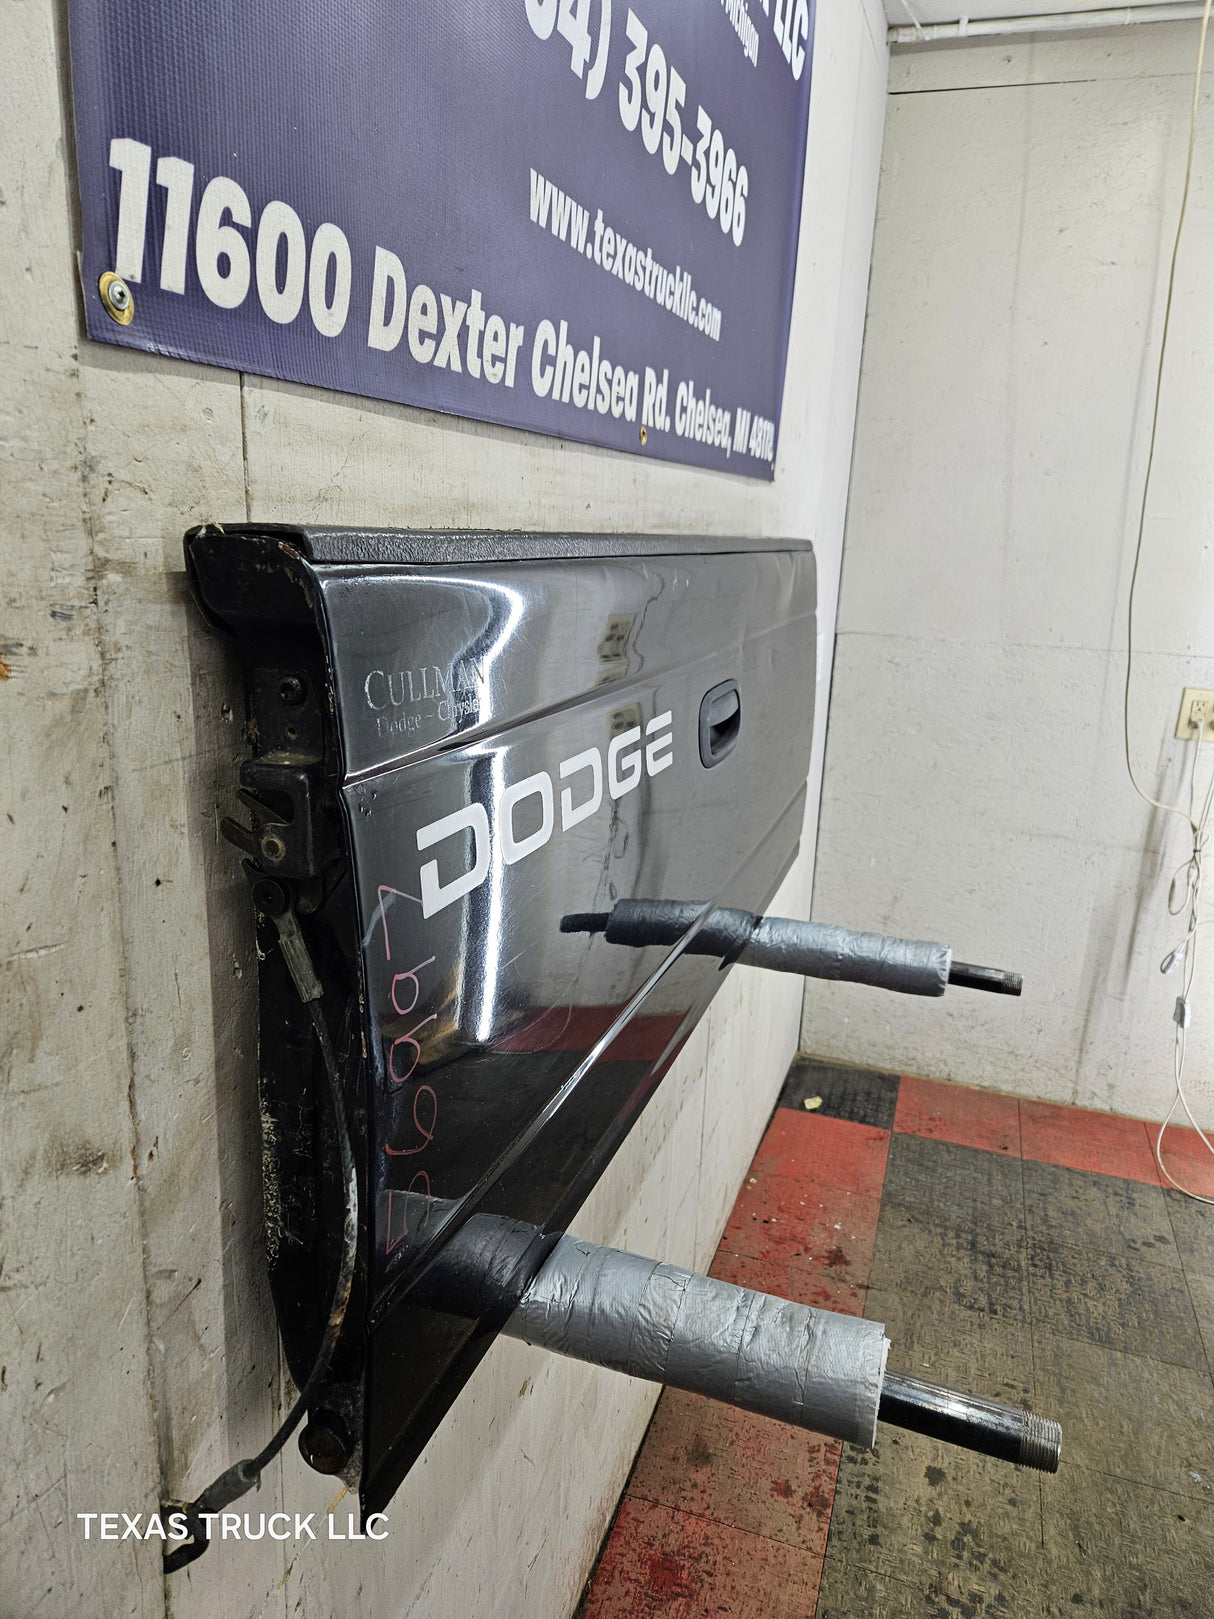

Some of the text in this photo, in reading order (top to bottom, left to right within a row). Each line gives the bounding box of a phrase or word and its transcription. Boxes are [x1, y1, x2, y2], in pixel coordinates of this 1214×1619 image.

[618, 7, 748, 248] 395-3966
[109, 137, 352, 338] 11600
[367, 245, 525, 388] Dexter
[531, 319, 639, 422] Chelsea
[642, 366, 671, 432] Rd.
[675, 380, 732, 459] Chelsea,
[732, 407, 752, 454] MI
[530, 167, 722, 342] www.texastruckllc.com
[376, 711, 422, 737] Dodge
[437, 692, 482, 724] Chrysle
[416, 710, 673, 920] DODGE
